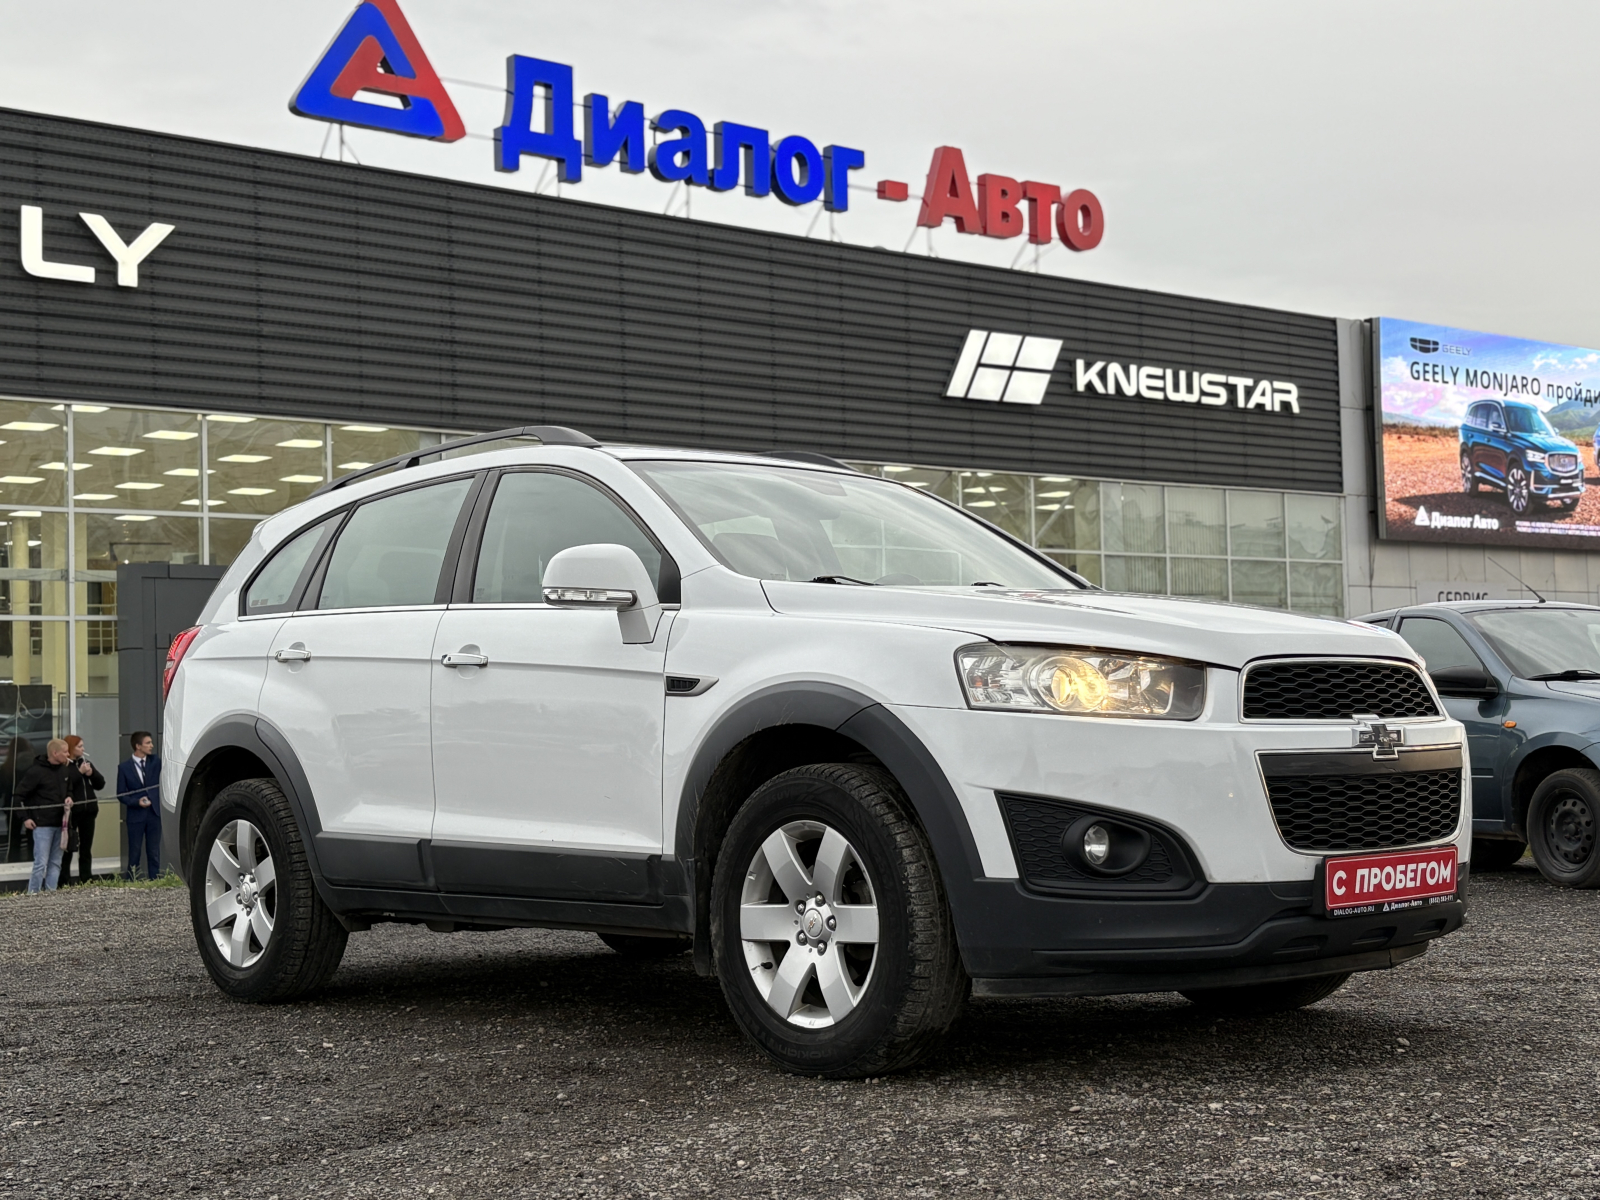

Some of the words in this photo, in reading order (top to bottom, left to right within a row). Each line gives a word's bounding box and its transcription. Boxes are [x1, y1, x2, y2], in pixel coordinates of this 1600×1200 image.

[21, 205, 176, 287] LY
[1442, 344, 1472, 356] GEELY
[1075, 358, 1300, 413] KNEWSTAR
[1410, 361, 1459, 385] GEELY
[1465, 368, 1541, 397] MONJARO
[1430, 511, 1473, 529] Диалог
[1473, 514, 1499, 530] Авто
[1332, 870, 1347, 896] С
[1354, 858, 1453, 894] ПРОБЕГОМ
[1333, 905, 1375, 916] DIALOG-AUTO.RU
